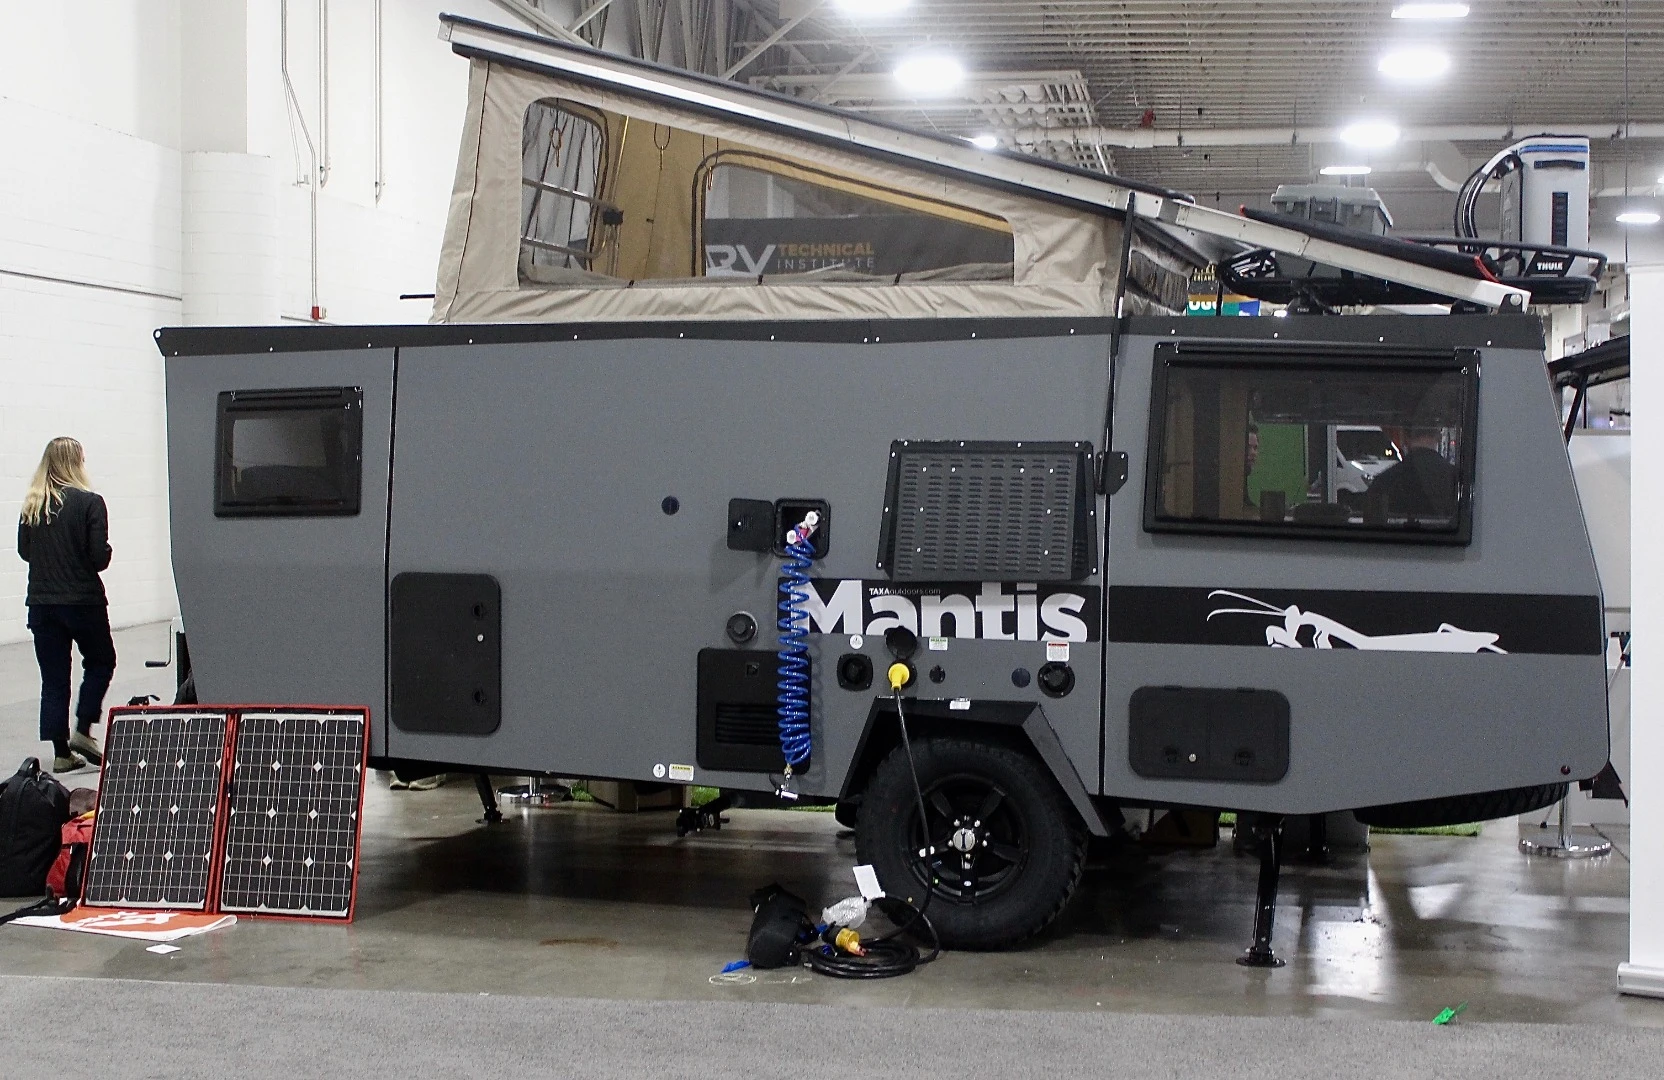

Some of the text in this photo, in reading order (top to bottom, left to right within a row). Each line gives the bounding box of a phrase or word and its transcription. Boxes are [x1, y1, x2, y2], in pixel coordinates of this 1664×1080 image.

[778, 242, 875, 257] TECHNICAL
[1537, 261, 1564, 271] THULE
[868, 587, 941, 596] TAXAoutdoors.com
[790, 579, 1088, 643] Mantis
